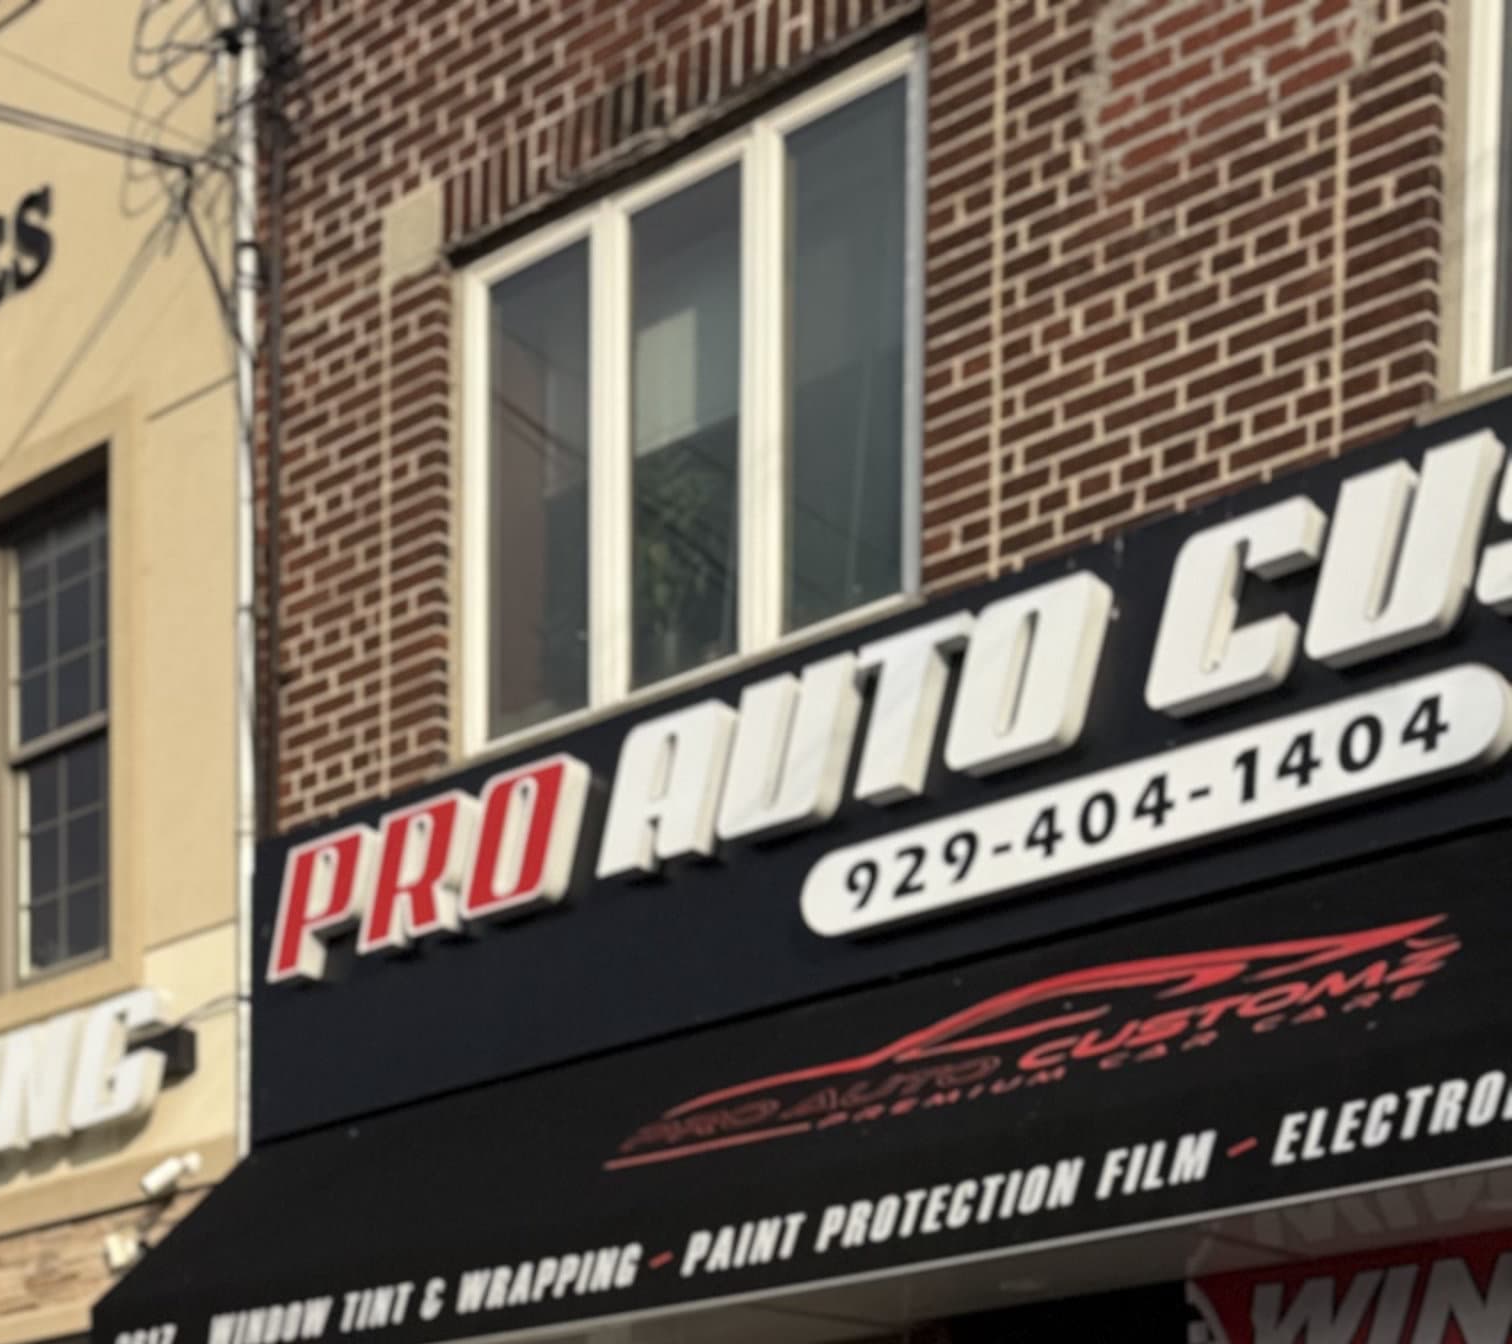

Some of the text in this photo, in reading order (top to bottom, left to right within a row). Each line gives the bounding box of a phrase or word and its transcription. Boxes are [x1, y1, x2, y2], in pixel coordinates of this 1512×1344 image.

[268, 752, 590, 982] PRO
[597, 571, 1113, 879] AUTO
[844, 694, 1450, 914] 929-404-1404
[817, 979, 1426, 1130] PREMIUM CAR CARE
[340, 1281, 415, 1333] TINT
[420, 1277, 446, 1321] &
[455, 1242, 643, 1314] WRAPPING
[682, 1211, 806, 1277] PAINT
[816, 1156, 1086, 1253] PROTECTION
[1095, 1130, 1217, 1200] FILM
[1270, 1069, 1512, 1167] ELECTRO
